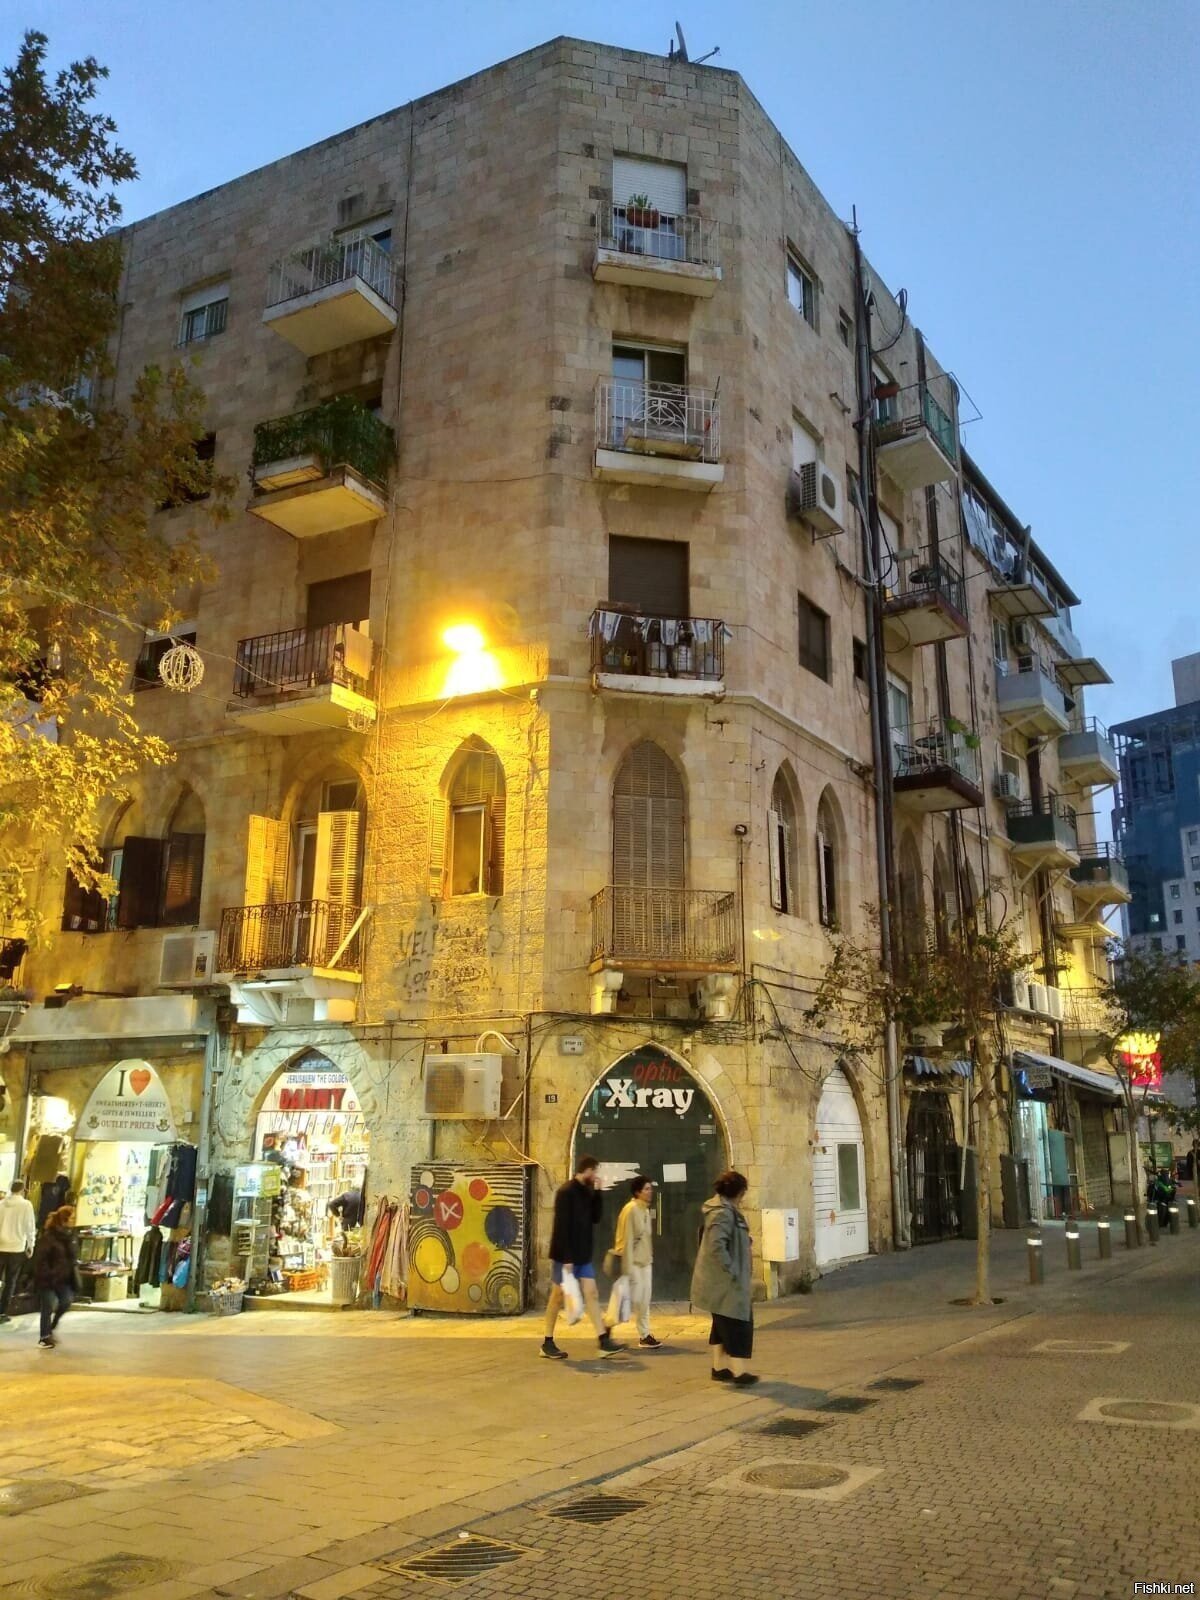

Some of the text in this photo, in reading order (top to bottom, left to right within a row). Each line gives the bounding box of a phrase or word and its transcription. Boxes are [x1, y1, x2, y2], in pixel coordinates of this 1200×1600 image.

[116, 1069, 127, 1097] I
[317, 1074, 327, 1084] THE
[328, 1074, 349, 1084] GOLDEN
[632, 1060, 683, 1087] optic
[279, 1088, 347, 1110] DANNY
[605, 1078, 695, 1115] Xray
[101, 1120, 156, 1130] OUTLET PRICES
